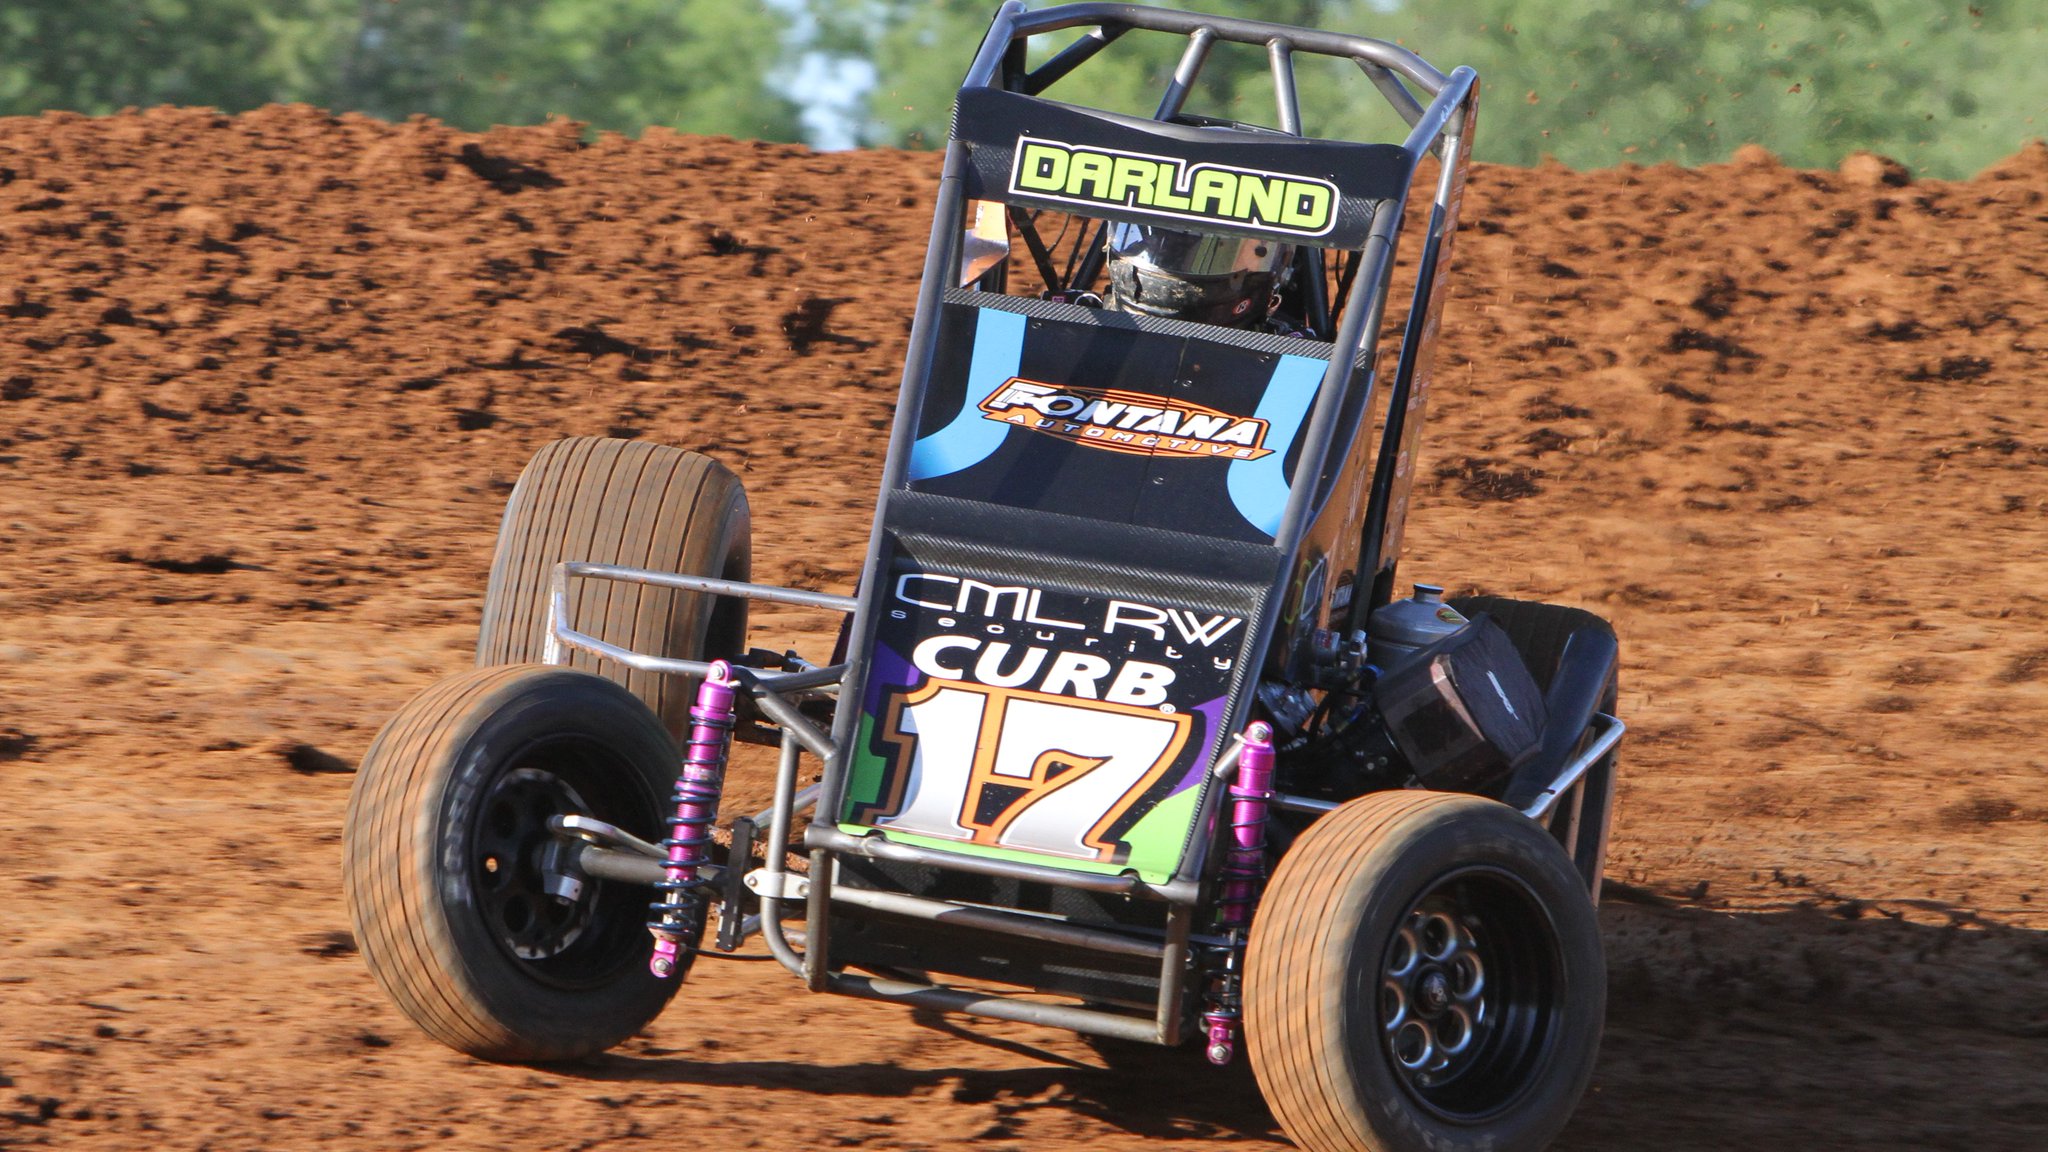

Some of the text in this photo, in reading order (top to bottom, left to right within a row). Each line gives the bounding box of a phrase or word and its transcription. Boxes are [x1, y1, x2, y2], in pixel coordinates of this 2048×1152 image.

[1019, 144, 1331, 229] DARLAND
[989, 381, 1260, 444] FONTANA
[1005, 413, 1254, 458] AUTOMOTIVE
[895, 573, 1242, 647] CML RW
[912, 635, 1177, 706] CURB
[866, 680, 1190, 862] 17
